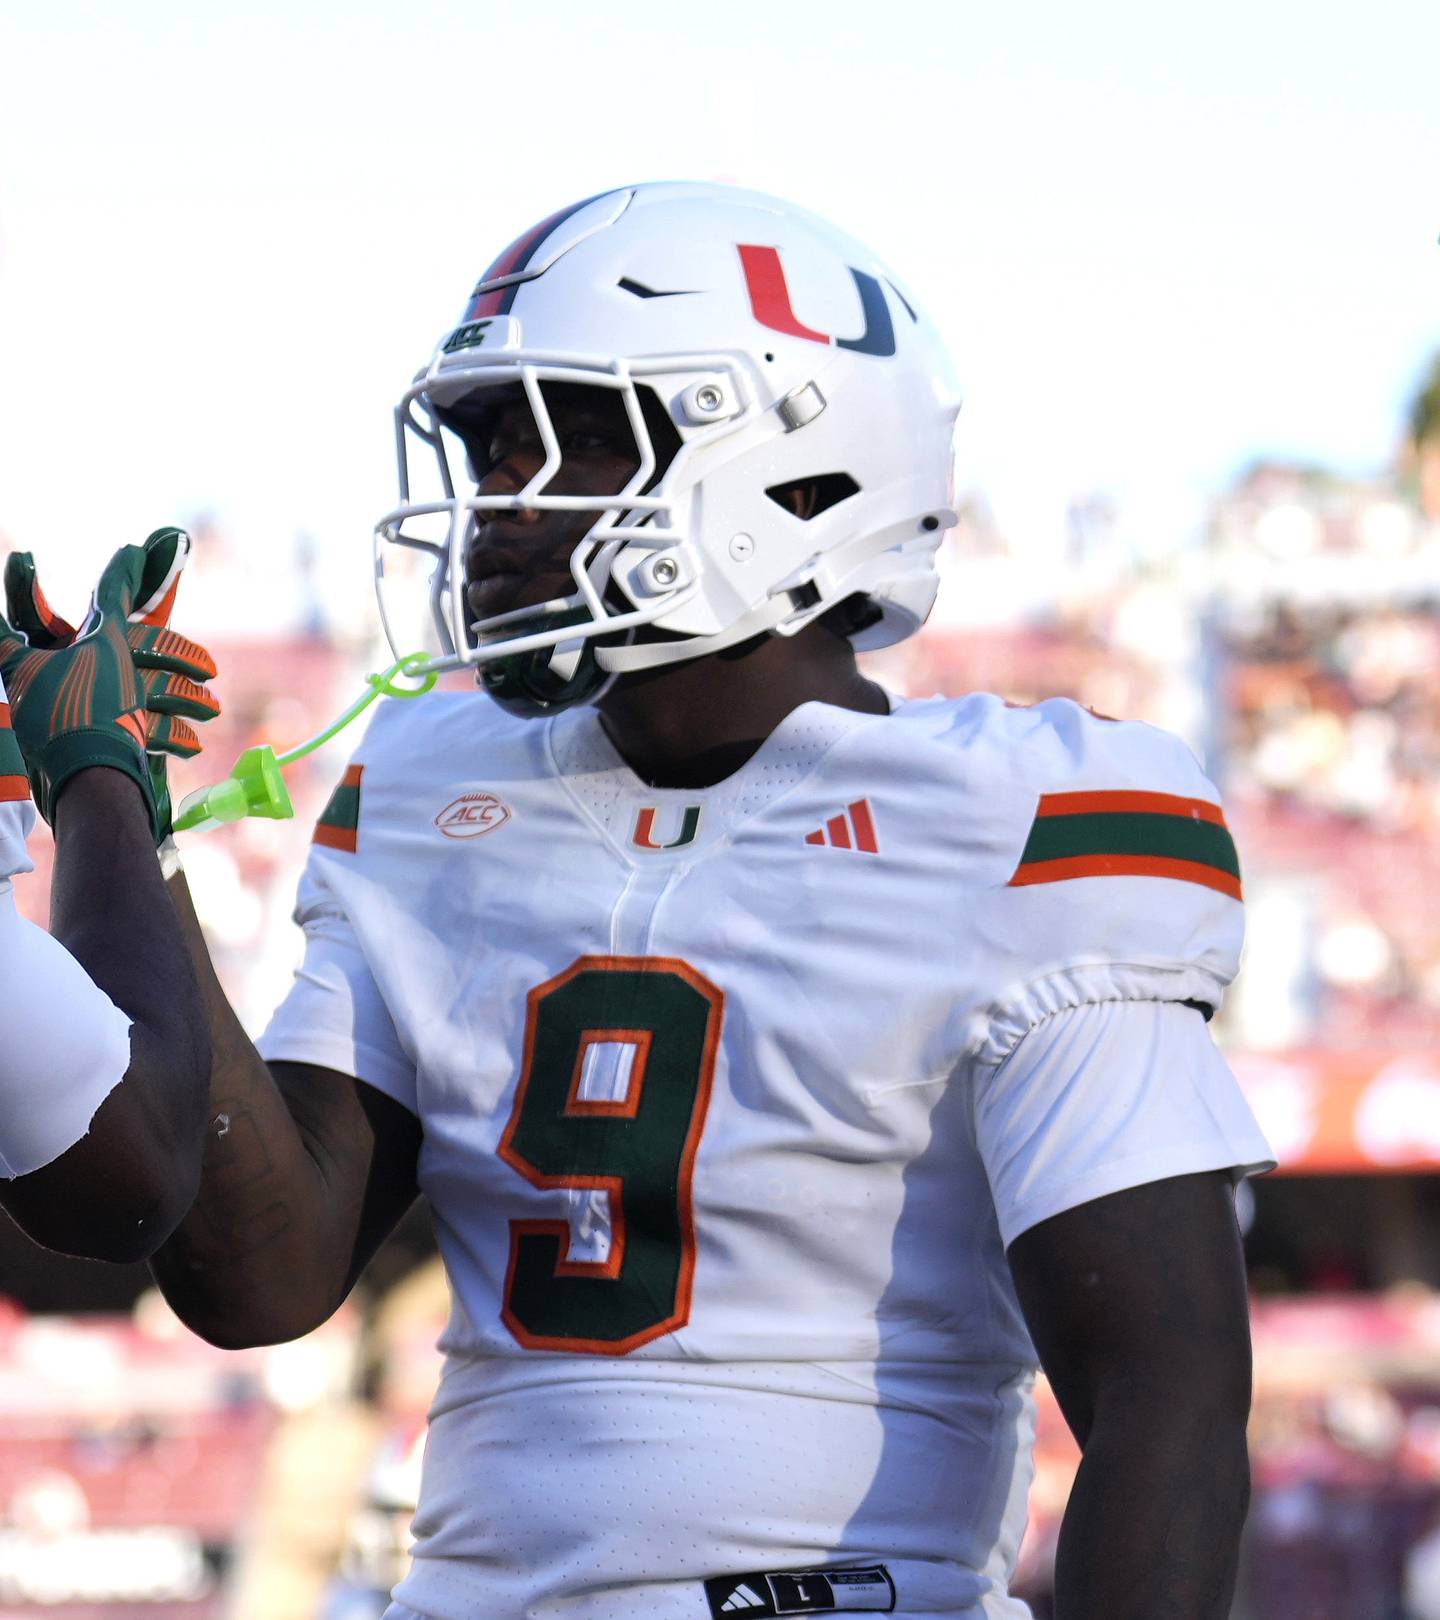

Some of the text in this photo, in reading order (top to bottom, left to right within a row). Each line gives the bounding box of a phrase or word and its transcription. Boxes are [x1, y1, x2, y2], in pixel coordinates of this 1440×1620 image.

[736, 243, 897, 357] U
[632, 806, 701, 849] U
[495, 954, 726, 1357] 9
[797, 1584, 810, 1601] L
